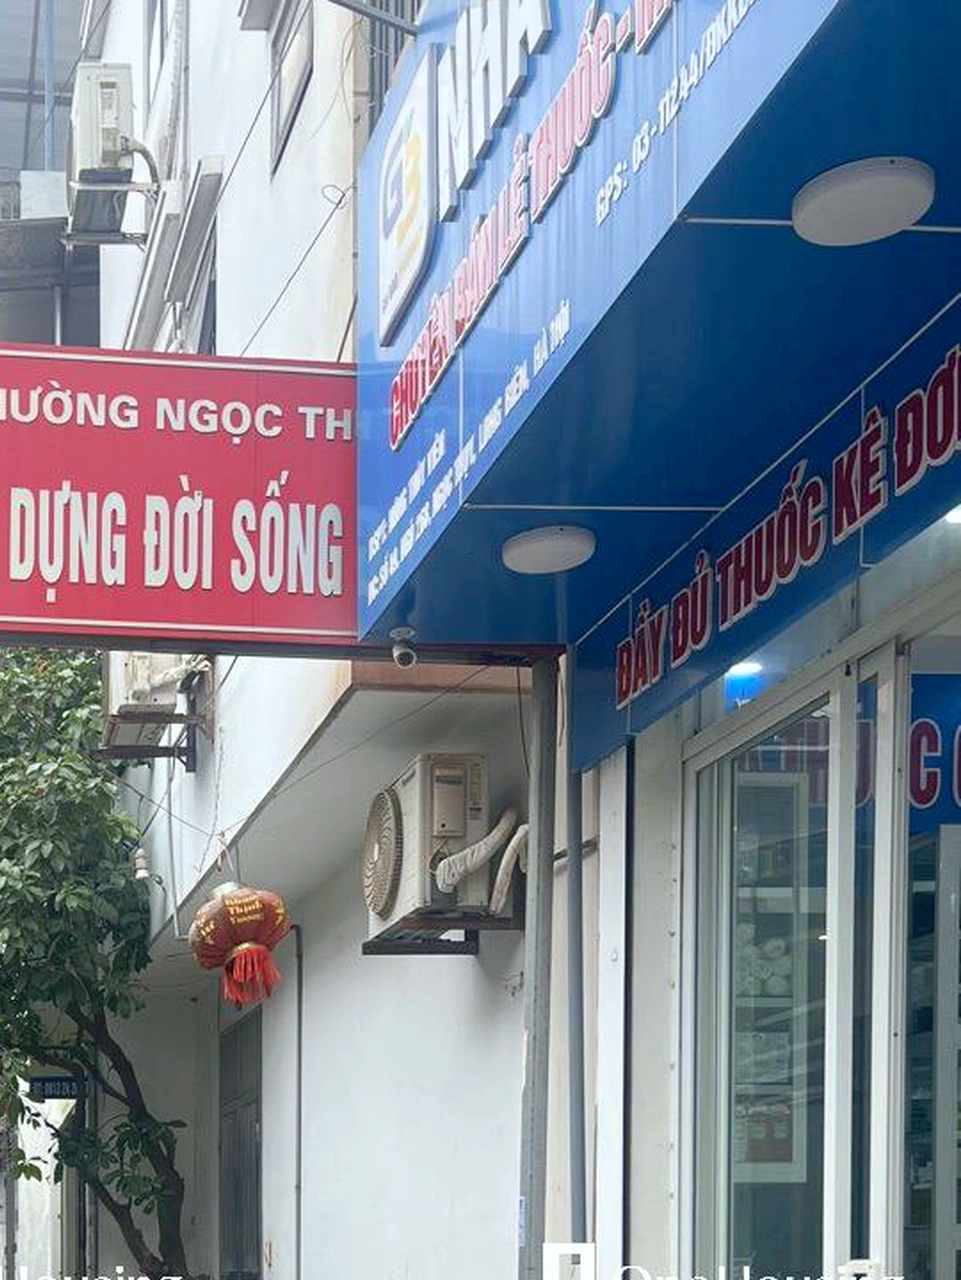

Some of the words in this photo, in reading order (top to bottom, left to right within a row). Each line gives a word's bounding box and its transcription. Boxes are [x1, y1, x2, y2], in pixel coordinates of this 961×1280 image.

[389, 292, 456, 451] CHUYÊN
[454, 214, 498, 342] BÁN
[498, 131, 529, 270] LẺ
[528, 0, 617, 223] THUỐC
[156, 397, 282, 445] NGỌC
[298, 405, 352, 441] TH
[670, 549, 713, 670] ĐỦ
[715, 458, 828, 633] THUỐC
[832, 405, 889, 546] KÊ
[893, 343, 961, 498] ĐƠ
[9, 479, 128, 603] DỰNG
[144, 474, 214, 590] ĐỜI
[231, 470, 343, 596] SỐNG
